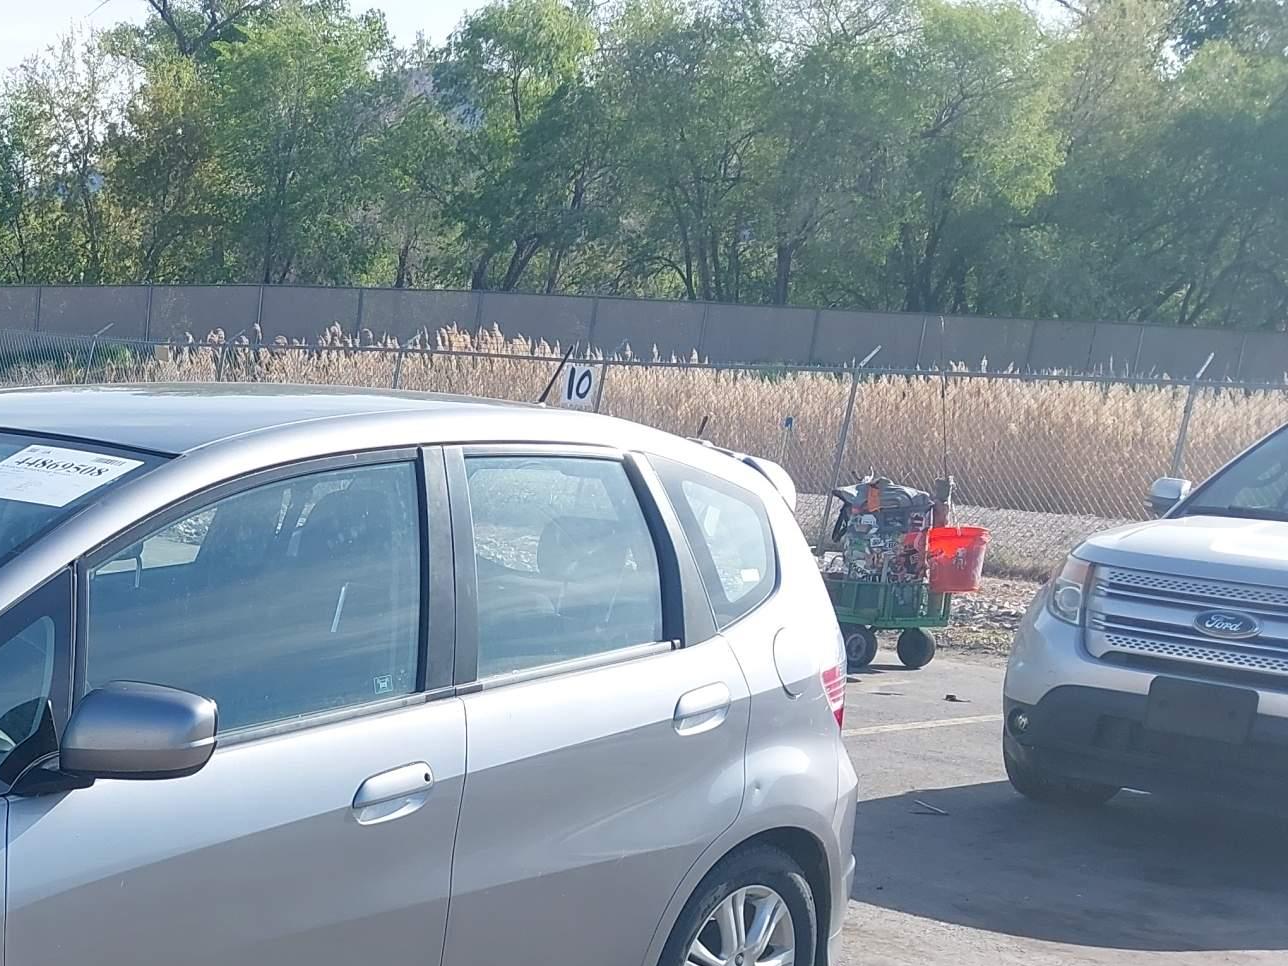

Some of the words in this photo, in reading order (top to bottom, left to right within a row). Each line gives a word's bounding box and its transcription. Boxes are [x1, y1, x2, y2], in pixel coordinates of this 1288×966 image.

[566, 366, 593, 401] 10
[14, 456, 110, 478] 44869508
[1204, 614, 1243, 632] Ford
